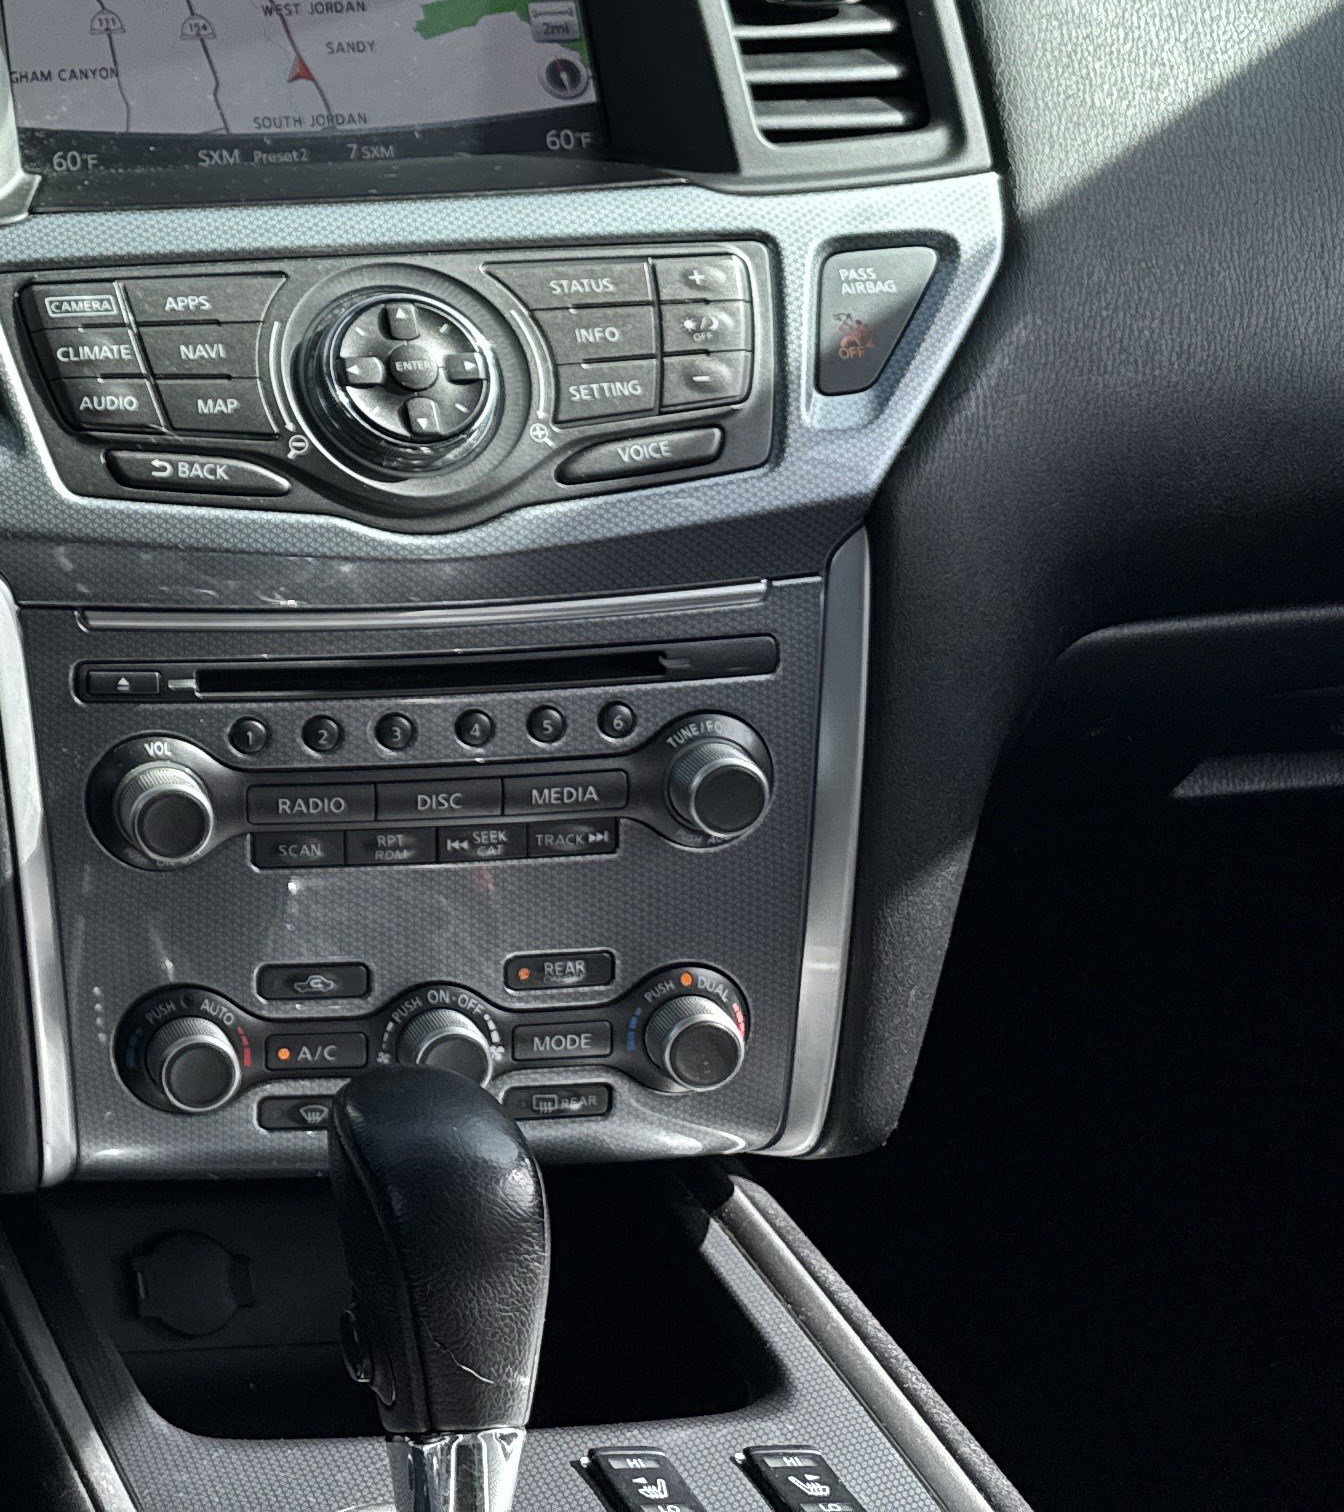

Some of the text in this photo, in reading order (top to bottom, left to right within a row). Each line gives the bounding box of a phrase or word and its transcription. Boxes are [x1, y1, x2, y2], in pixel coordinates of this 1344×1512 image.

[261, 0, 367, 18] WEST JORDAN
[542, 20, 570, 36] 2mi
[324, 39, 377, 56] SANDY
[57, 66, 120, 81] CANYON
[252, 112, 369, 130] SOUTH JORDAN
[196, 147, 242, 168] SXM
[345, 143, 359, 161] 7
[362, 144, 396, 160] SXM
[838, 267, 877, 282] PASS
[549, 277, 615, 296] STATUS
[840, 279, 899, 296] AIRBAG
[50, 298, 111, 314] CAMERA
[163, 294, 213, 312] APPS
[574, 326, 621, 344] INFO
[692, 332, 714, 342] OFF
[56, 344, 134, 363] CLIMATE
[179, 342, 228, 361] NAVI
[838, 345, 867, 360] OFF
[394, 359, 435, 373] ENTER
[568, 379, 643, 402] SETTING
[78, 394, 140, 412] AUDIO
[196, 397, 241, 415] MAP
[616, 440, 673, 464] VOICE
[177, 461, 231, 481] BACK
[468, 722, 482, 739] 4
[541, 719, 555, 735] 5
[612, 714, 625, 731] 6
[245, 730, 254, 747] 1
[316, 729, 330, 745] 2
[391, 726, 403, 742] 3
[143, 740, 173, 759] VOL
[416, 792, 464, 812] DISC
[531, 784, 599, 806] MEDIA
[277, 796, 347, 815] RADIO
[376, 833, 406, 848] RPT
[472, 828, 509, 844] SEEK
[535, 831, 587, 849] TRACK
[277, 841, 325, 858] SCAN
[374, 848, 411, 862] RDM
[477, 844, 506, 858] CAT
[543, 958, 587, 978] REAR
[643, 974, 730, 1004] PUSH DUAL
[145, 997, 237, 1028] PUSH AUTO
[392, 996, 424, 1025] PUSH
[532, 1032, 594, 1053] MODE
[296, 1044, 339, 1062] A/C
[560, 1094, 598, 1110] REAR
[625, 1457, 648, 1470] HI
[781, 1455, 804, 1468] HI
